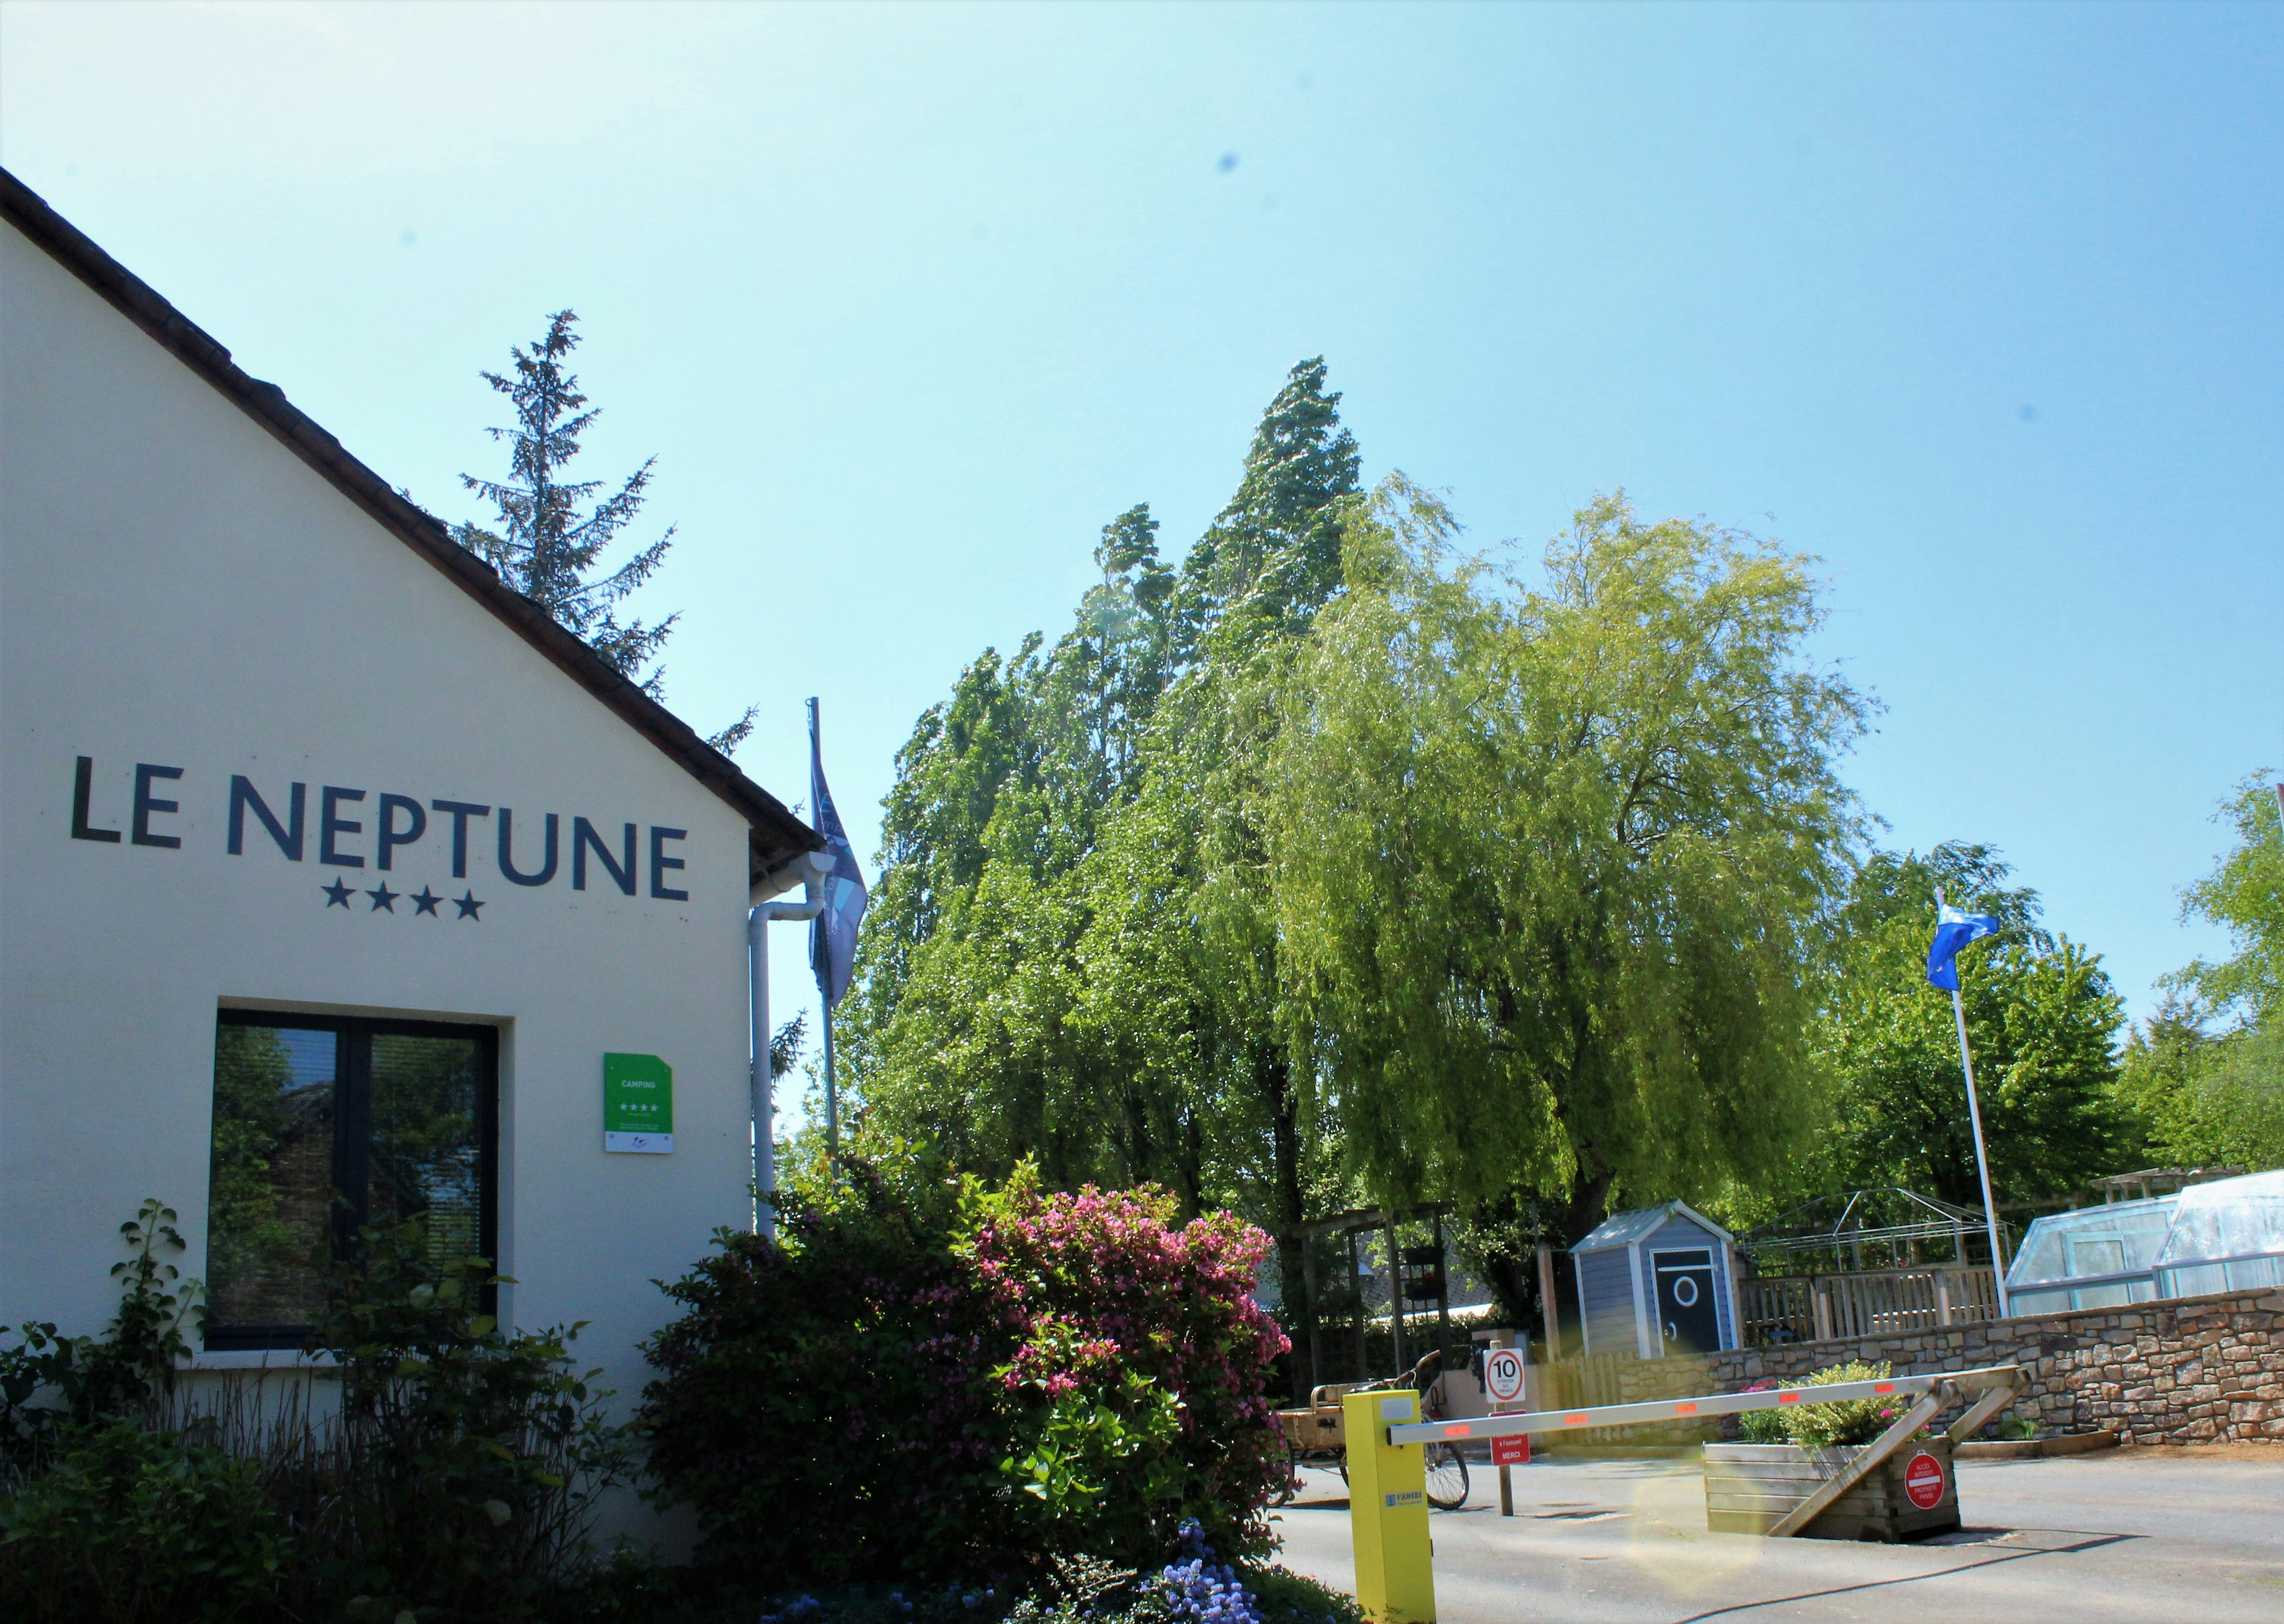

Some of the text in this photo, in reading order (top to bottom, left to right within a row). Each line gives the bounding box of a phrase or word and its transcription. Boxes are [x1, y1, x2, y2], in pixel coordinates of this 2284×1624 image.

[71, 756, 690, 901] LE NEPTUNE
[1493, 1360, 1516, 1377] 10
